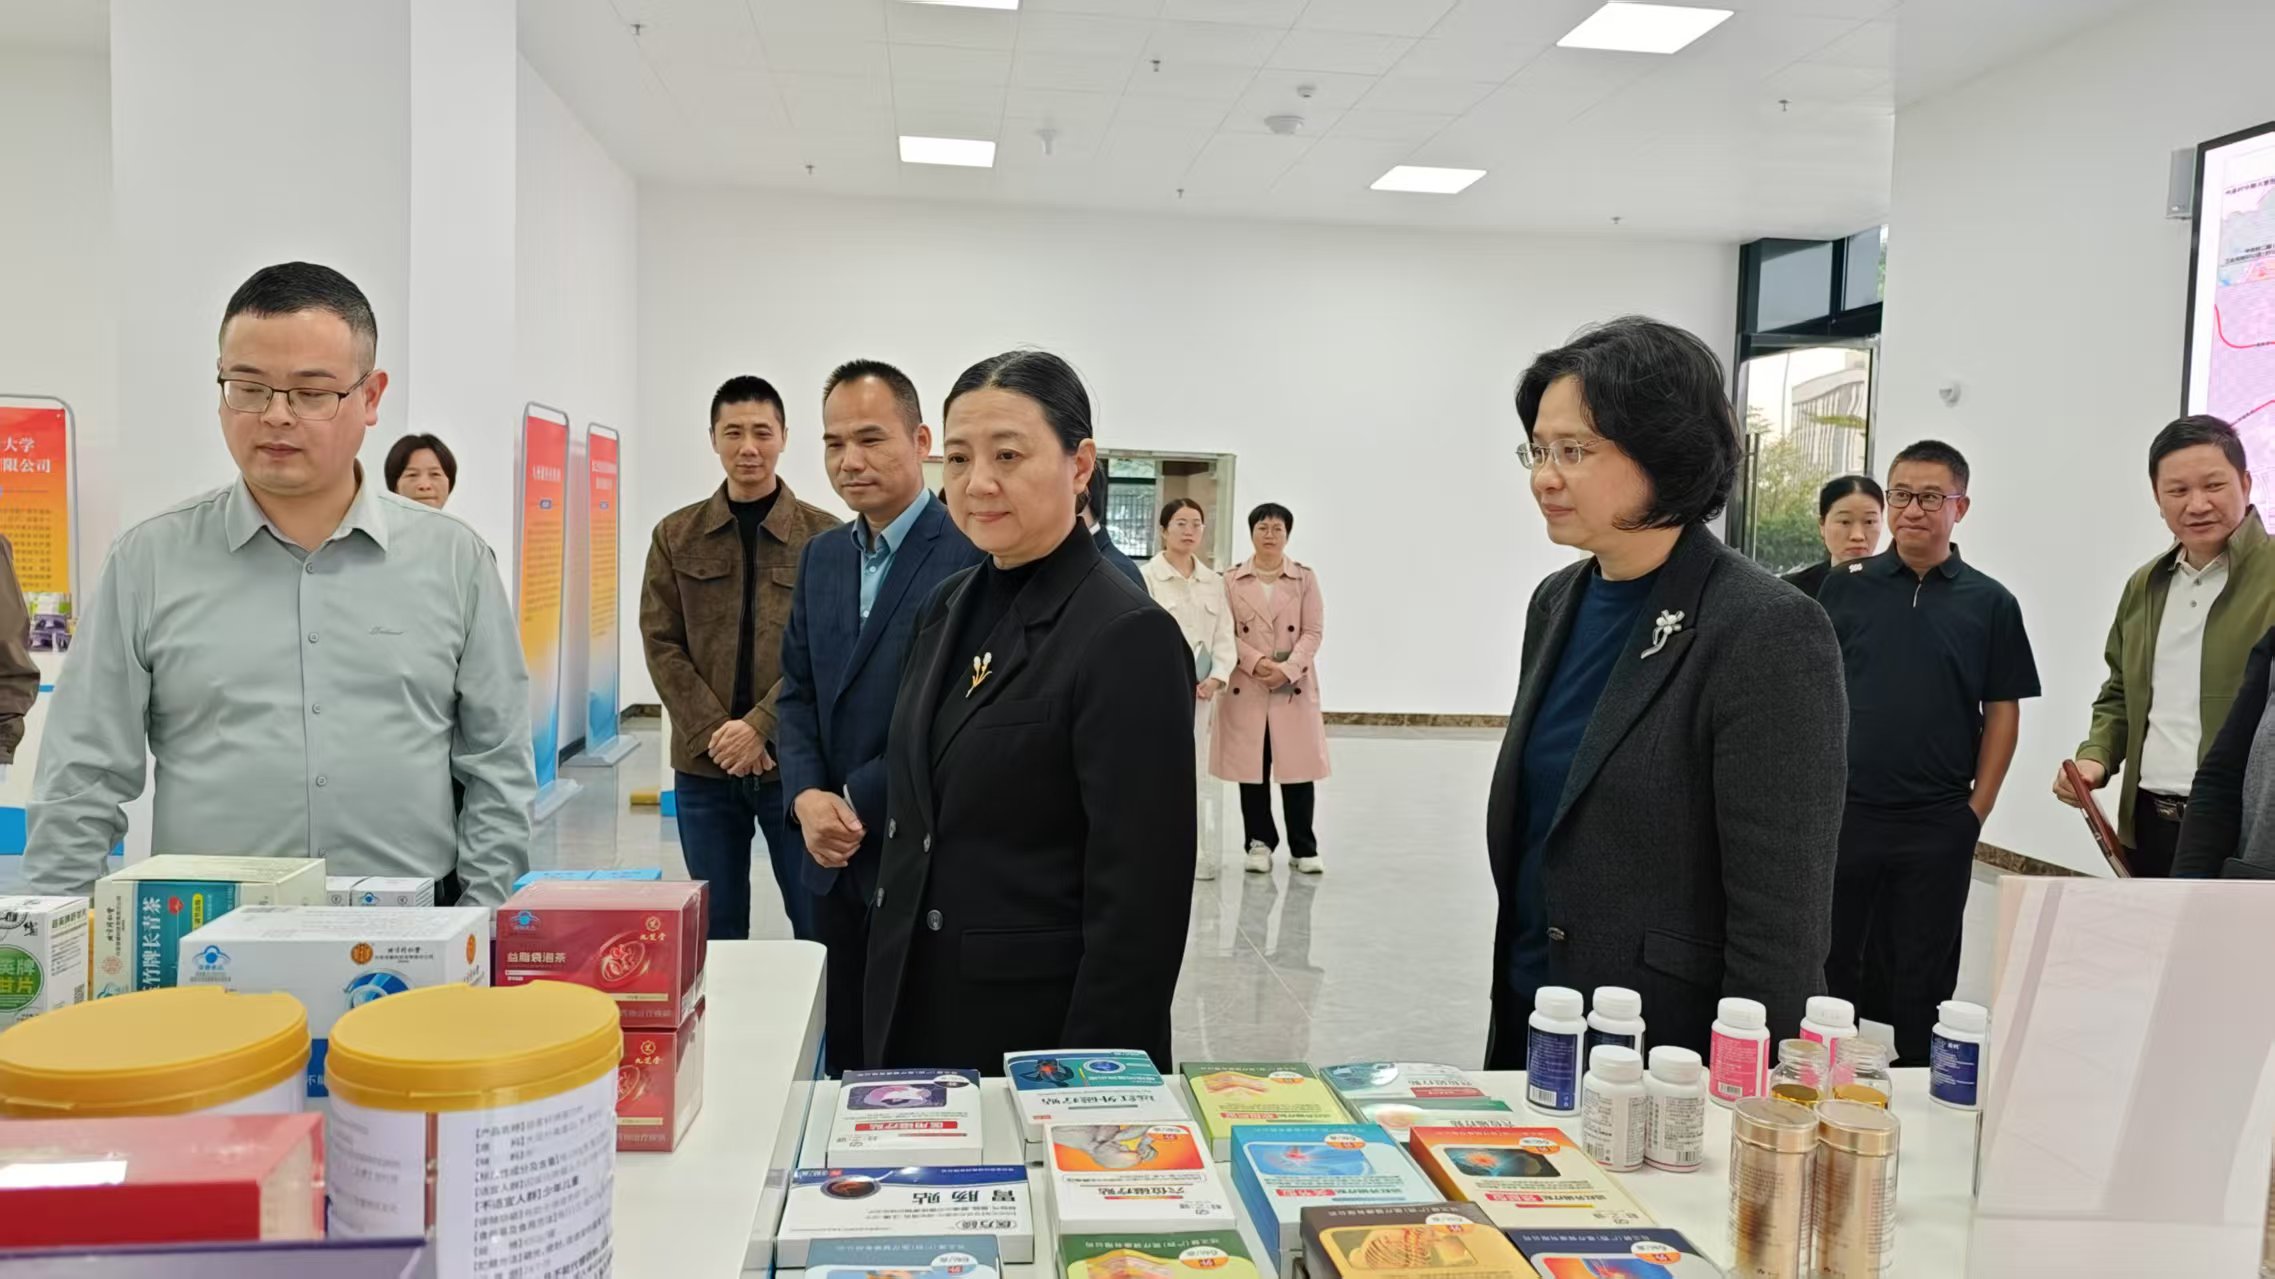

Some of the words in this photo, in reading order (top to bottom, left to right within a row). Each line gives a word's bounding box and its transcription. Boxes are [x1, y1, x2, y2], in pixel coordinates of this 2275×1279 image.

[0, 458, 51, 473] 限公司
[142, 897, 161, 990] 竹牌长青茶
